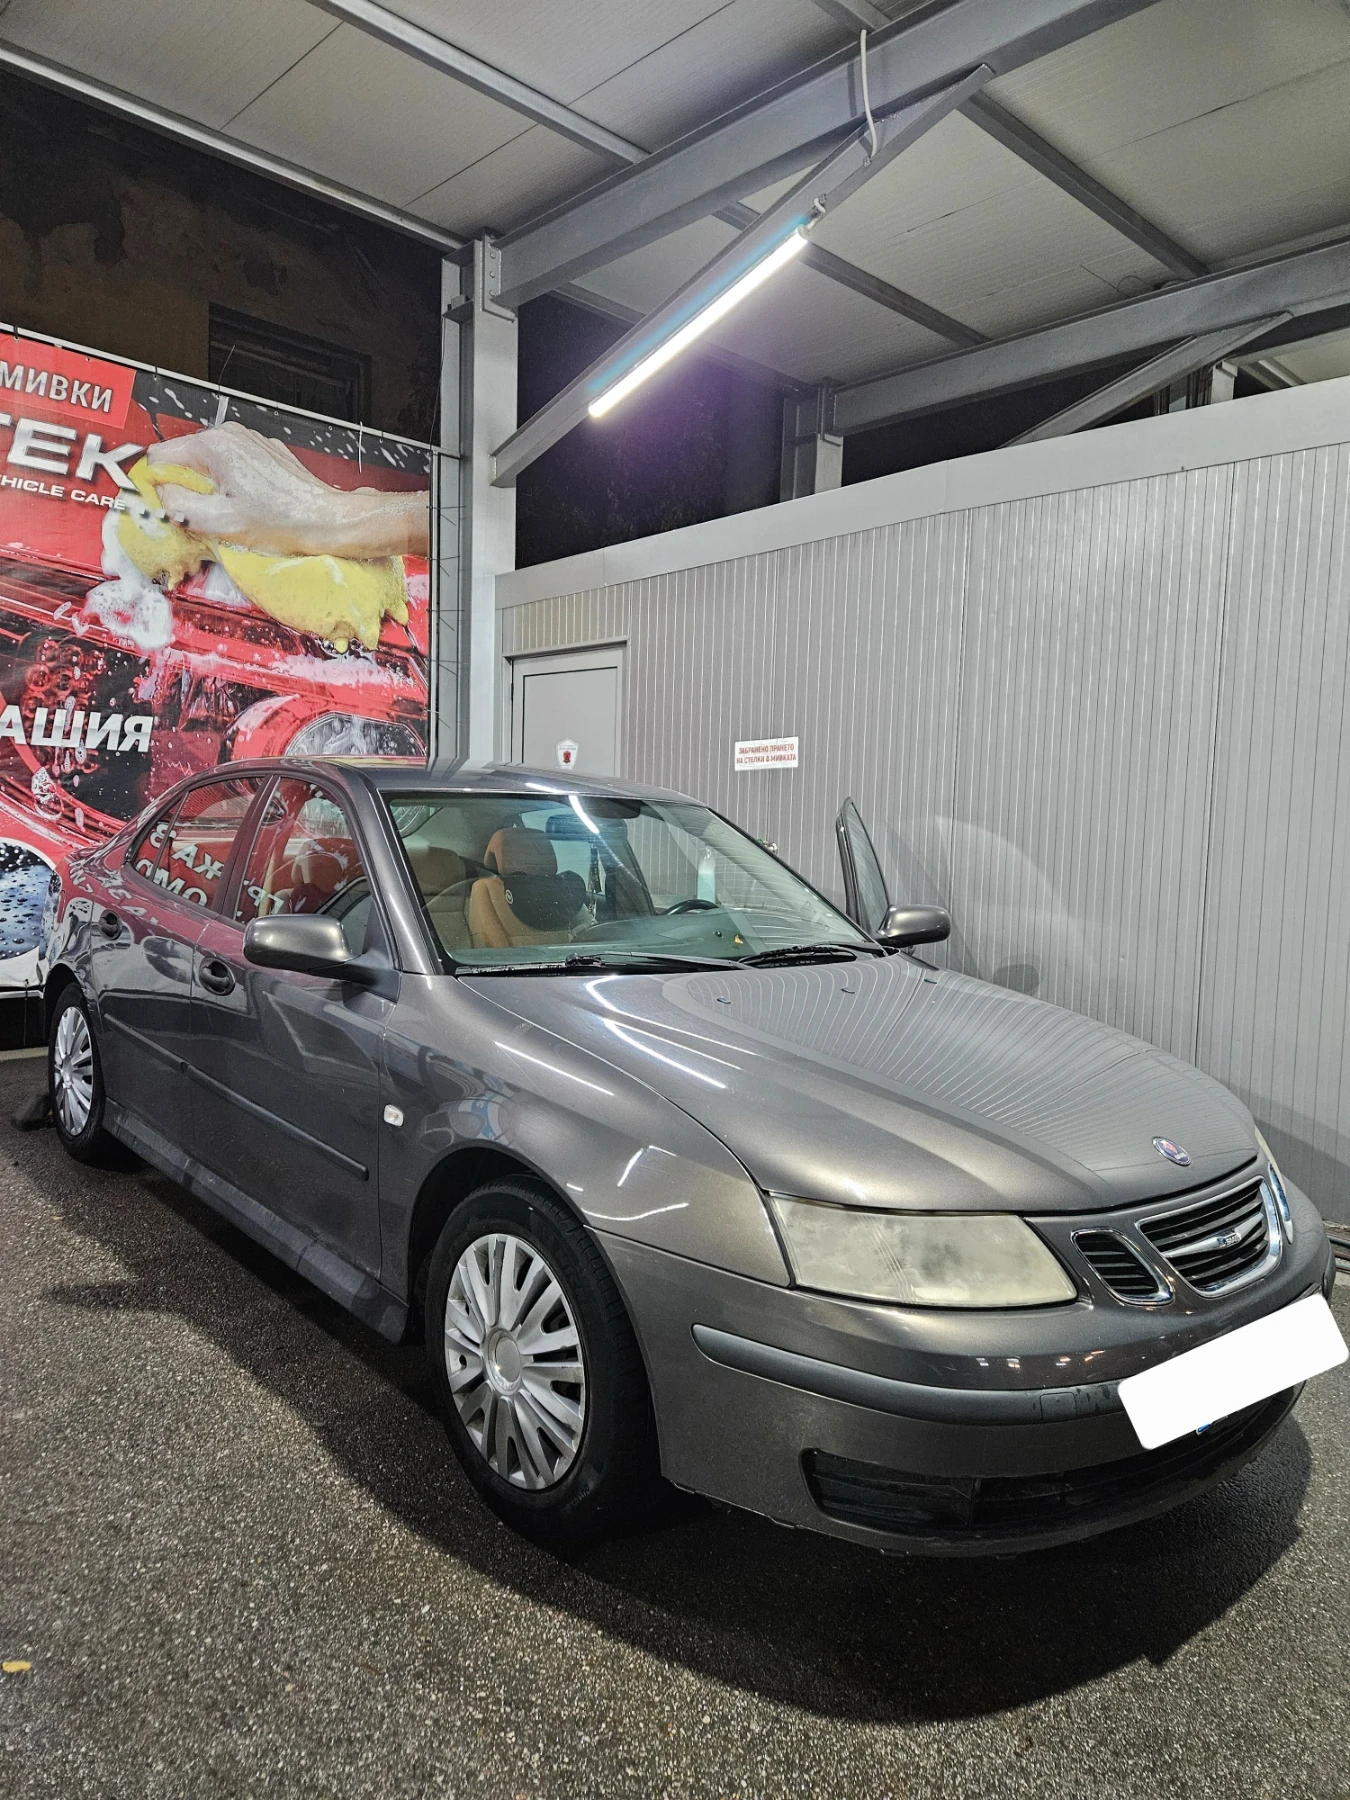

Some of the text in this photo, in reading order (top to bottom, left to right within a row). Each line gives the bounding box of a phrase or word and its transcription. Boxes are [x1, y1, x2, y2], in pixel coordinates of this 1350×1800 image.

[0, 474, 127, 511] HICLE CARE
[739, 743, 795, 755] ЗАБРАНЕНО ПРАНЕТО
